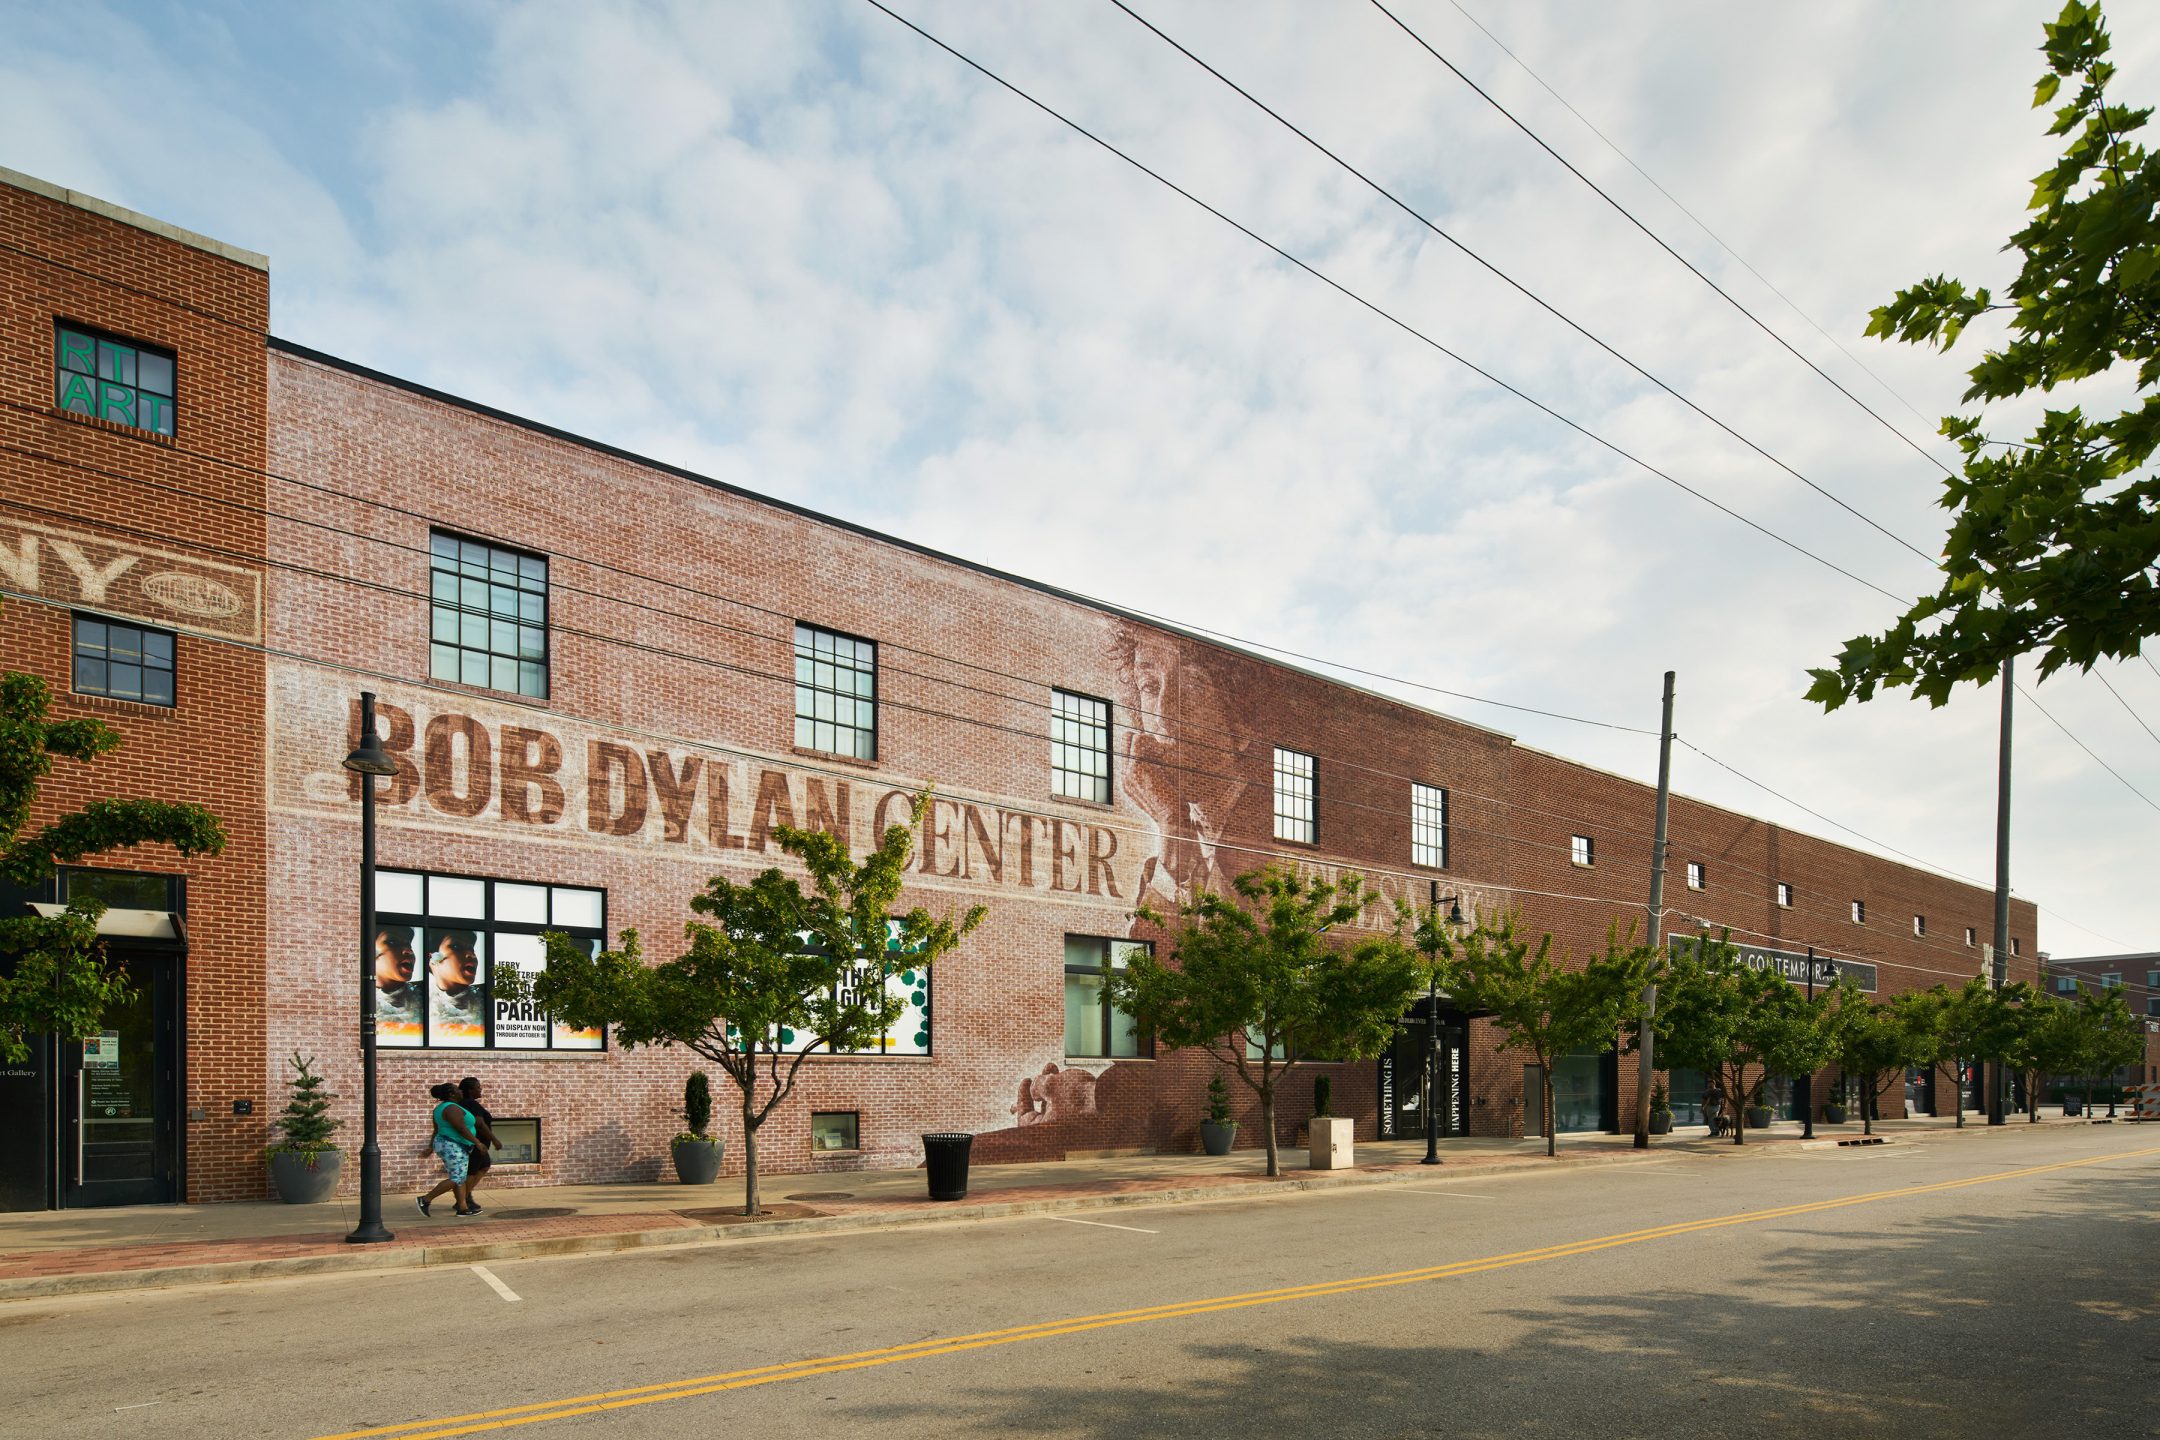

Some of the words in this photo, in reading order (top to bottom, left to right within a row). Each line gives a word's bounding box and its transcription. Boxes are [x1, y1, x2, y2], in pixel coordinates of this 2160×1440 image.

[61, 375, 171, 433] ART
[347, 700, 565, 825] BOB
[587, 740, 851, 857] DYLAN
[873, 789, 1124, 898] CENTER
[7, 1069, 37, 1077] Gallery
[1383, 1058, 1393, 1069] IS
[1451, 1048, 1459, 1072] HERE
[1383, 1071, 1393, 1134] SOMETHING
[1451, 1073, 1460, 1130] HAPPENING
